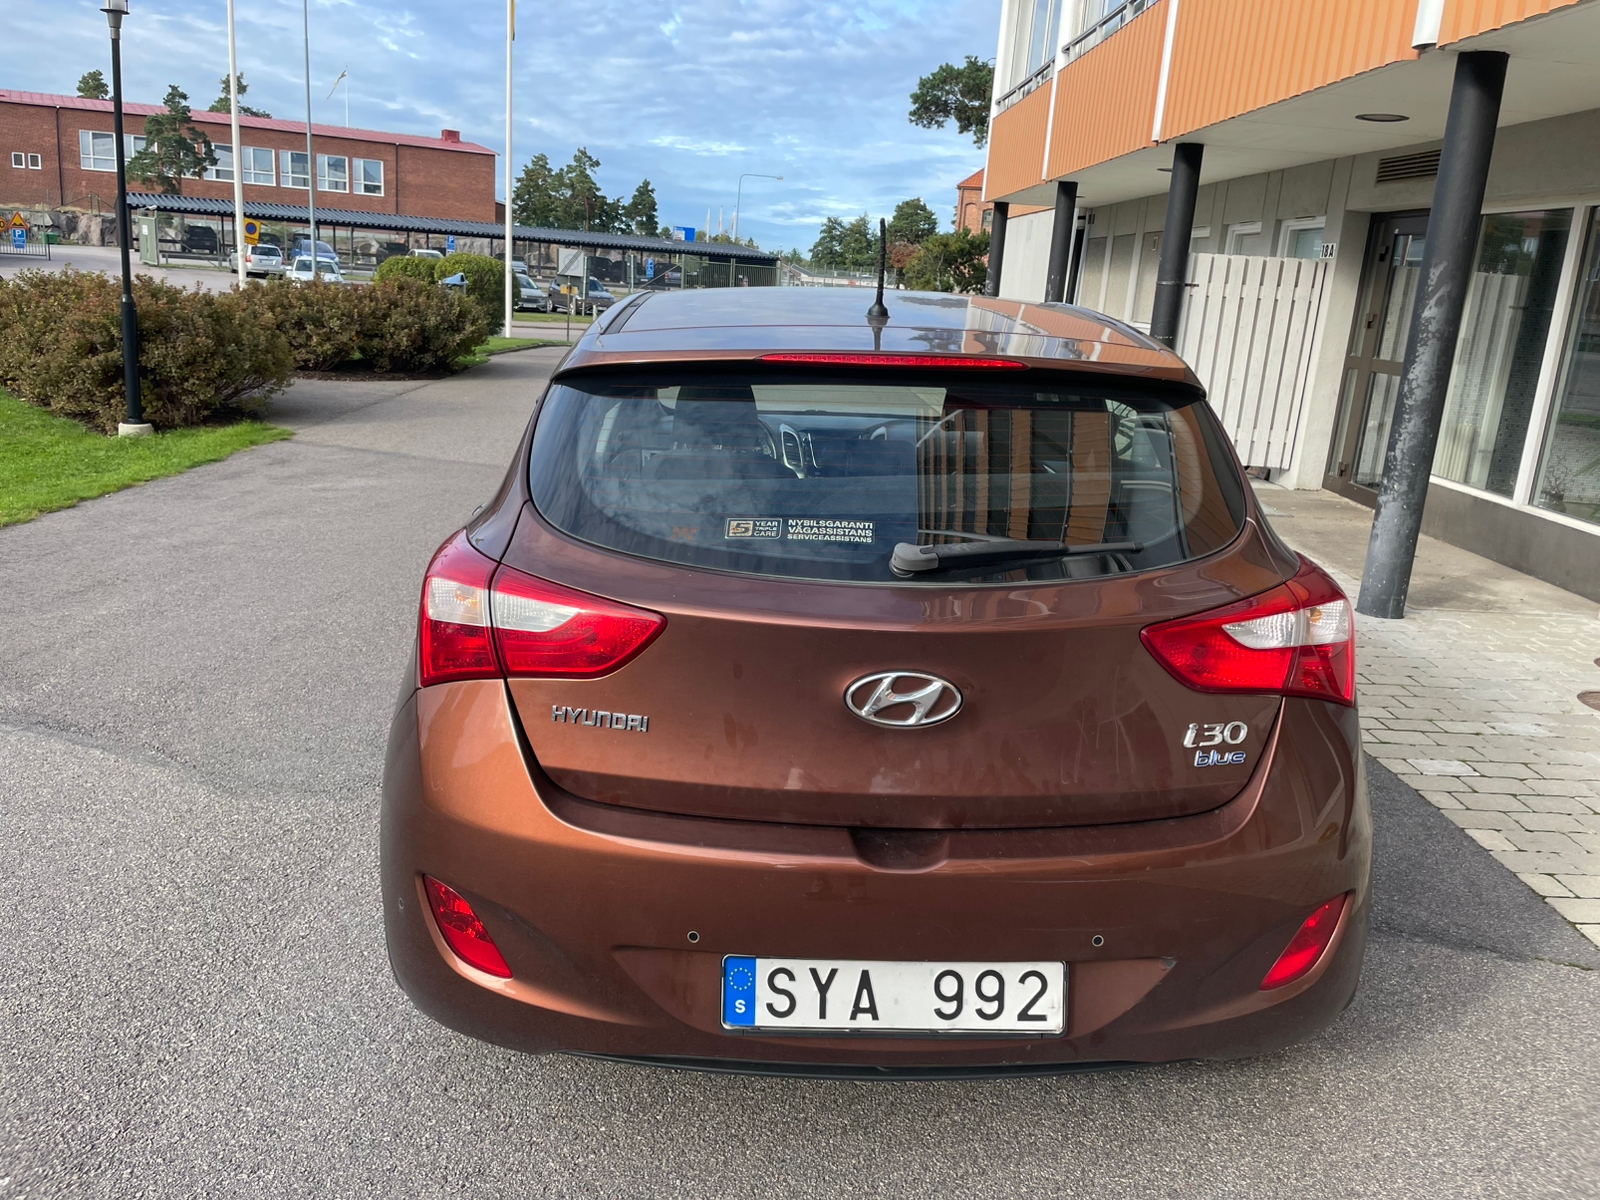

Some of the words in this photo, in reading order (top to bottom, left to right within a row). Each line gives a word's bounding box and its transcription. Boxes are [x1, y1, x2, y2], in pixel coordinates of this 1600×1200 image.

[16, 230, 22, 238] P
[788, 519, 873, 529] NYBILSGARANTI
[787, 534, 872, 543] SERVICEASSISTANS
[551, 705, 649, 732] HYUNDAI
[1183, 721, 1248, 748] i30
[1194, 750, 1246, 767] blue
[735, 999, 746, 1014] S
[765, 967, 880, 1021] SYA
[933, 969, 1049, 1022] 992
